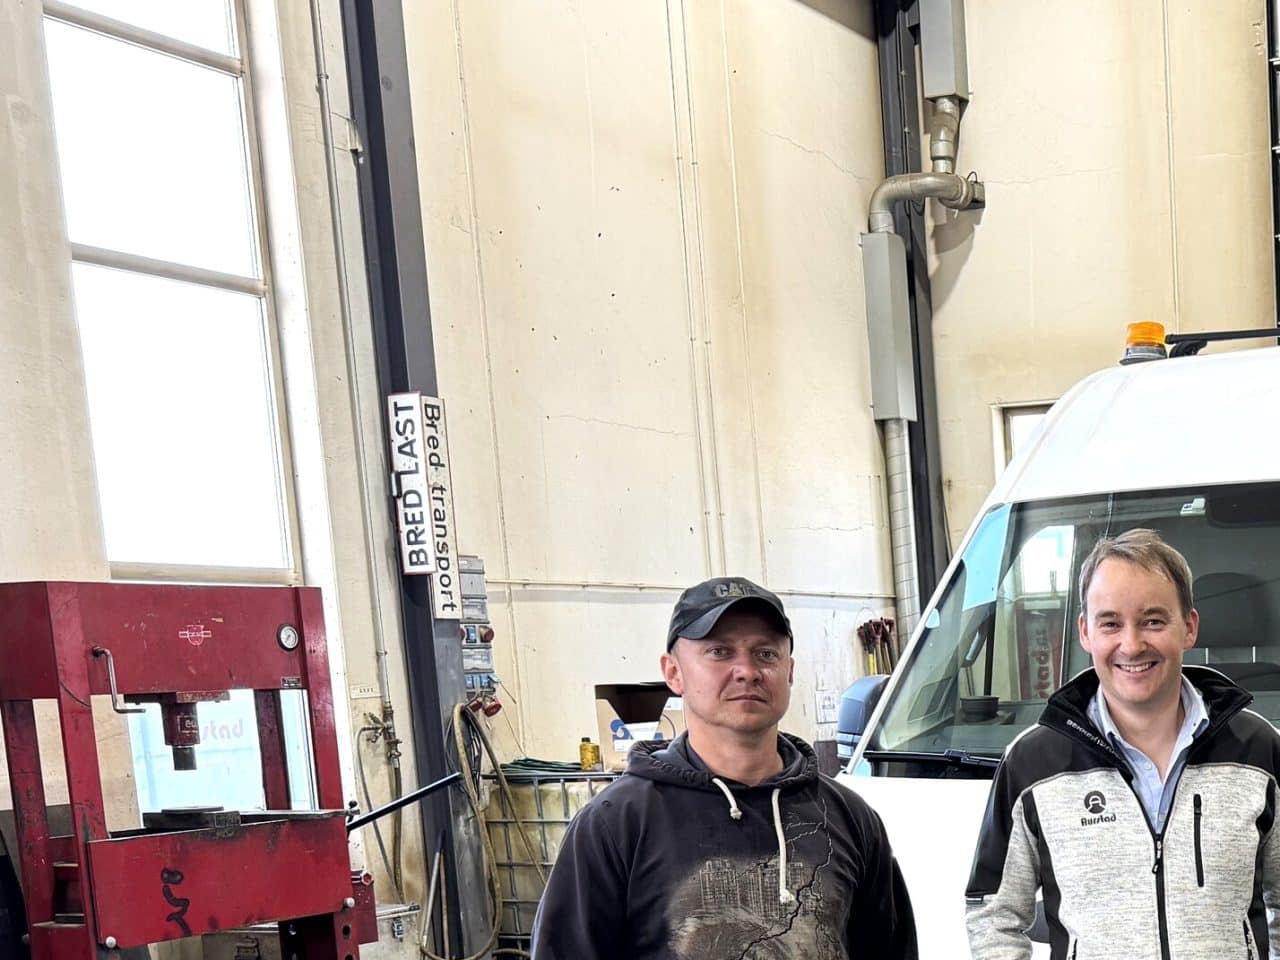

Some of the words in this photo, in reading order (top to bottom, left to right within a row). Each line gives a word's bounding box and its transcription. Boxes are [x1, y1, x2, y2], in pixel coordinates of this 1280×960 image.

[394, 401, 419, 475] LAST
[424, 403, 446, 468] Bred
[403, 489, 429, 567] BRED
[431, 485, 457, 612] transport
